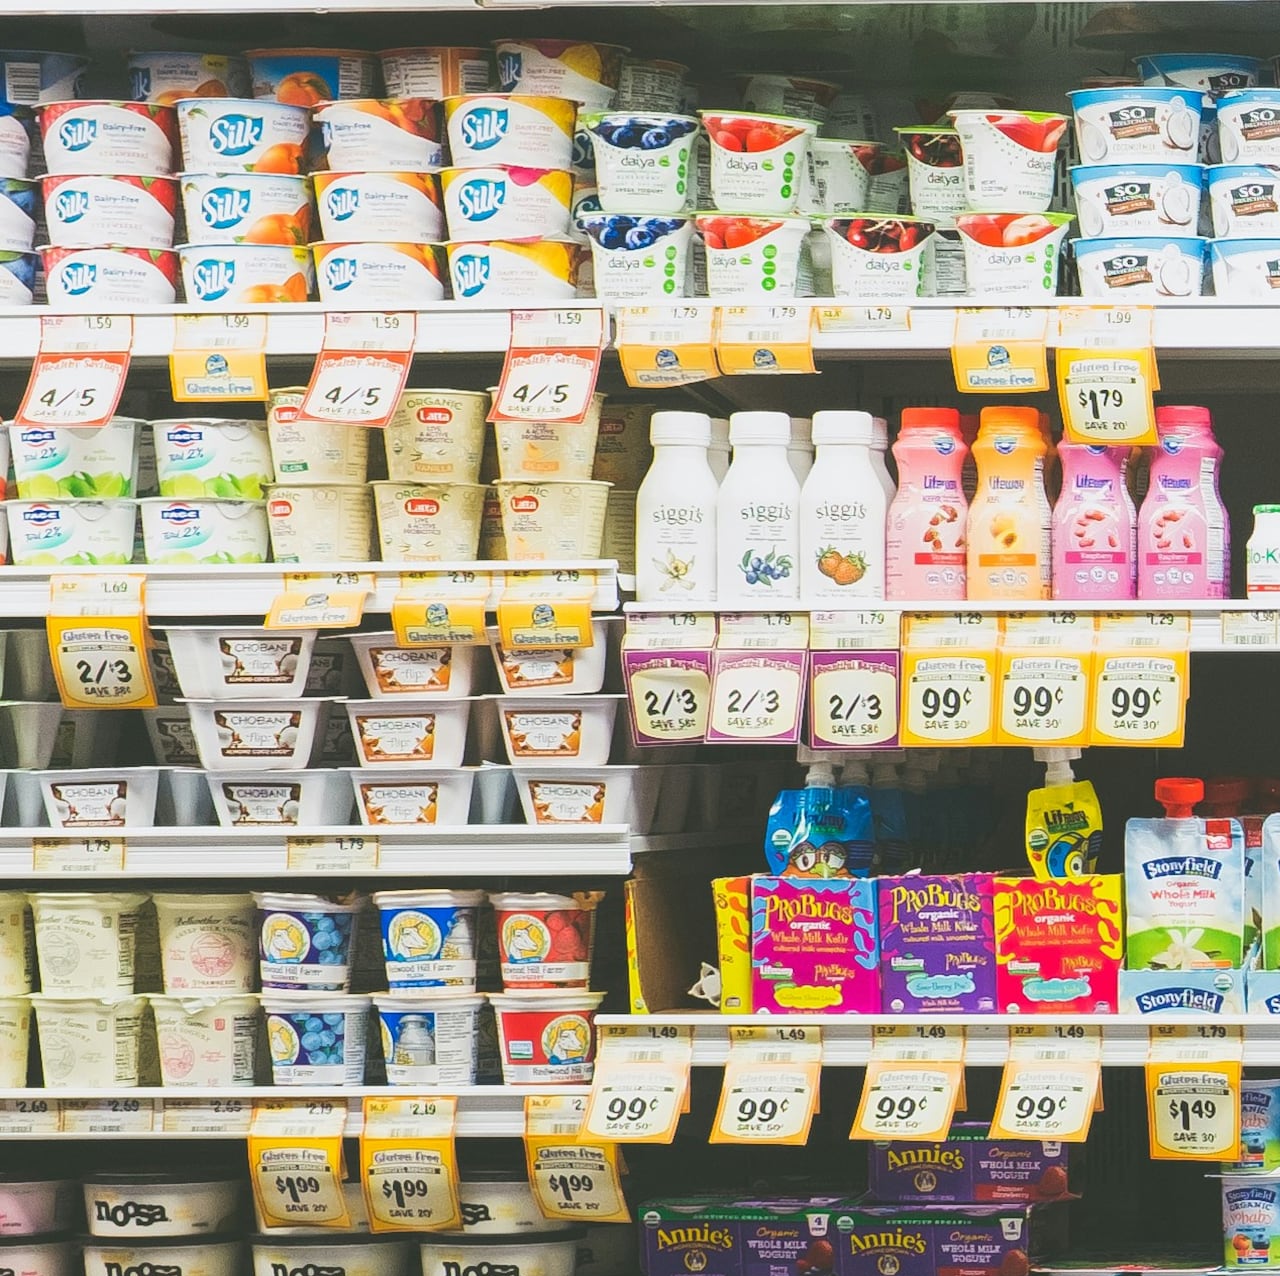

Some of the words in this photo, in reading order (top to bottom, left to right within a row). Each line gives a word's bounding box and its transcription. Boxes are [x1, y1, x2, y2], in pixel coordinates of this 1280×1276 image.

[1119, 106, 1142, 120] SO
[60, 124, 96, 150] Silk
[214, 118, 262, 152] Silk
[928, 172, 960, 186] daiya
[652, 506, 704, 524] siggi's
[1144, 858, 1218, 878] Stonyfield
[1186, 888, 1216, 900] Milk
[886, 1145, 964, 1171] Annie's
[656, 1222, 733, 1250] Annie's
